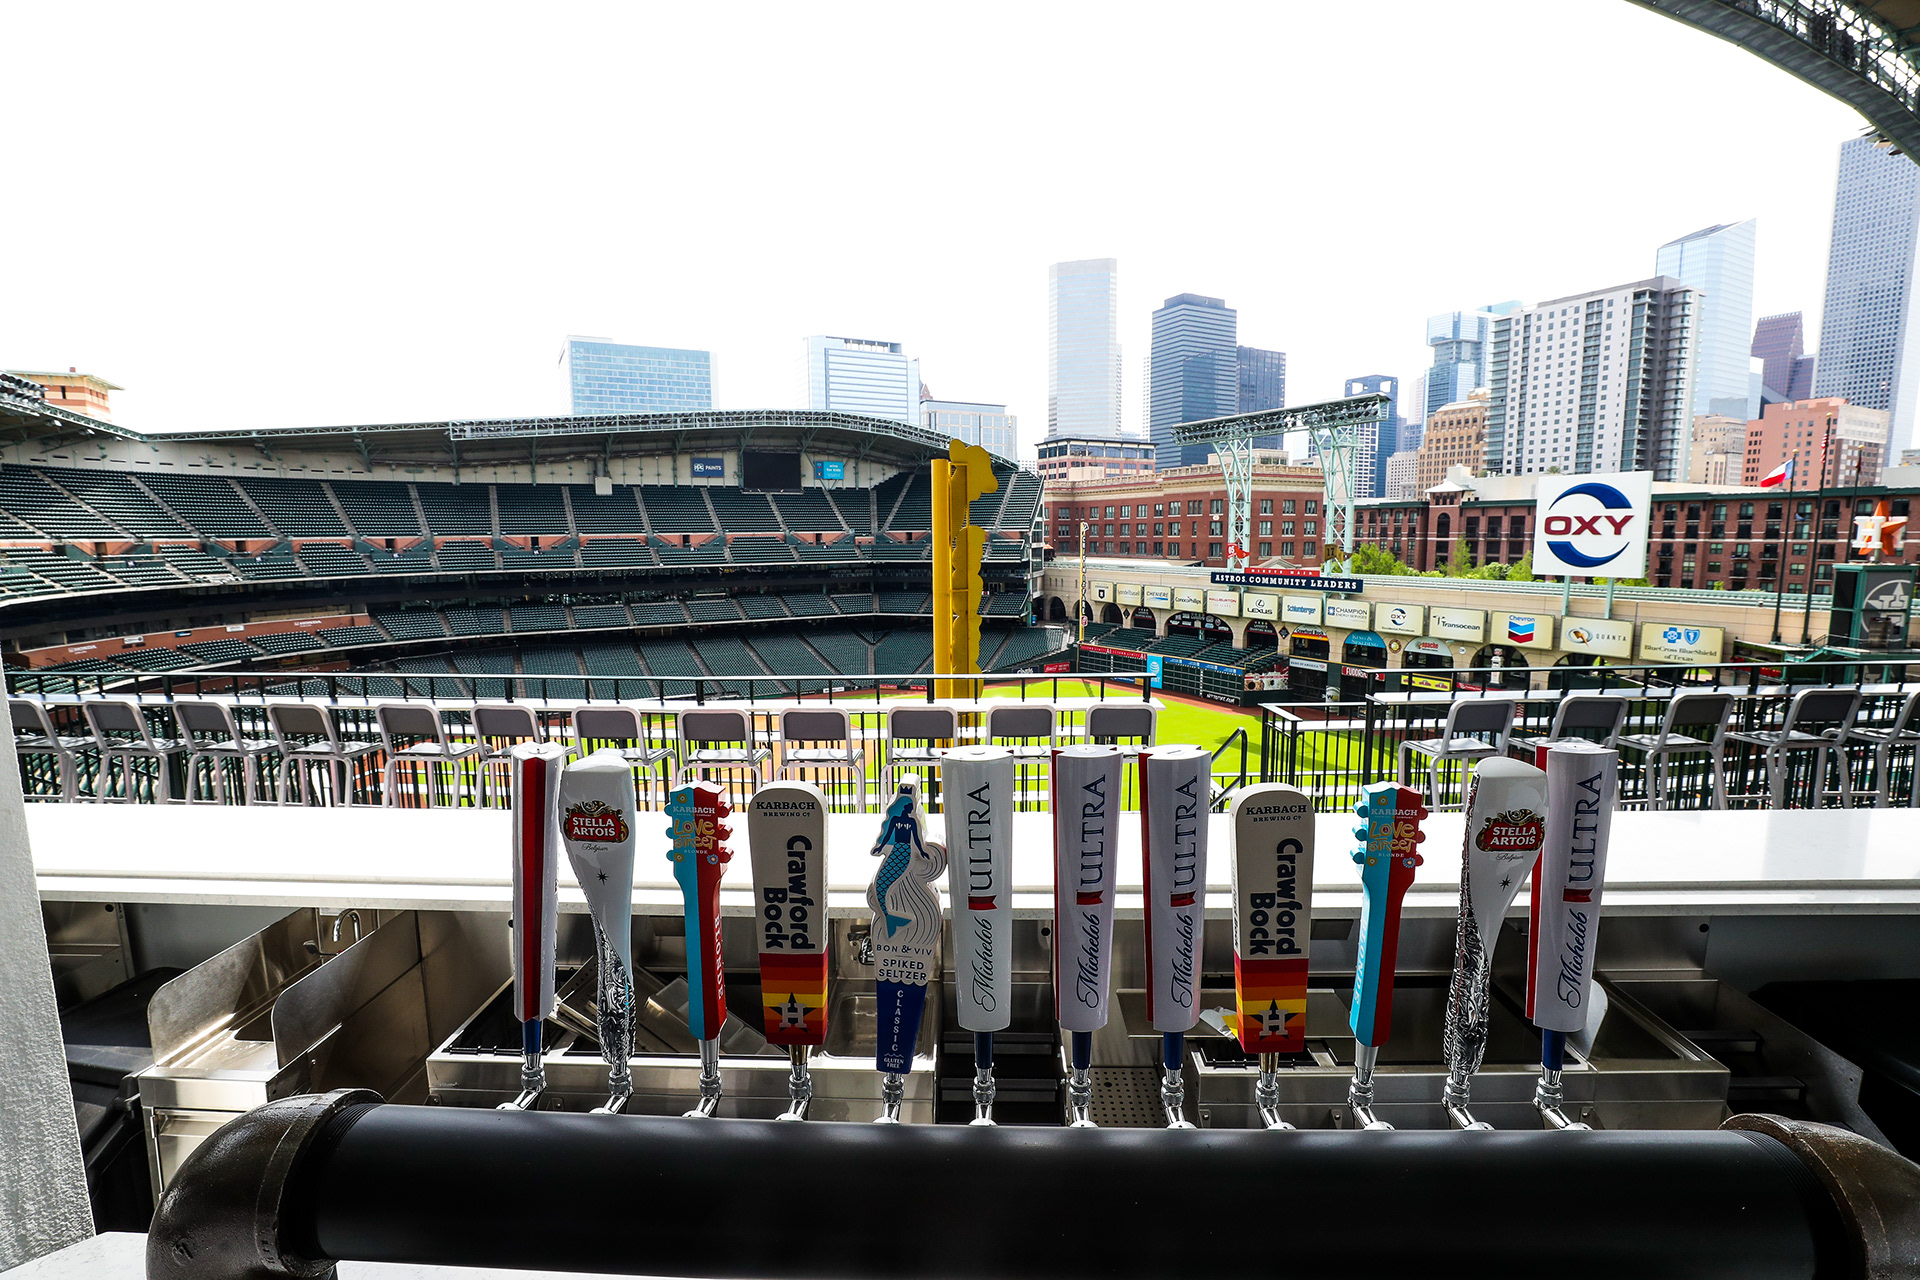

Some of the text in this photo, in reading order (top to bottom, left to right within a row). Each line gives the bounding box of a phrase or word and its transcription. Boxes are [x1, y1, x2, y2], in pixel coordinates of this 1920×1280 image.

[1544, 514, 1635, 536] OXY
[1852, 516, 1886, 548] H
[1327, 547, 1334, 556] 17
[1249, 576, 1306, 586] COMMUNITY
[1310, 580, 1357, 589] LEADERS
[1287, 604, 1317, 616] Schlumberger
[1336, 607, 1367, 615] CHAMPION
[1442, 620, 1480, 630] Transocean
[1644, 644, 1717, 656] BlueCross BlueShield
[756, 801, 815, 810] KARBACH
[1246, 805, 1307, 815] KARBACH
[573, 817, 614, 826] STELLA
[573, 827, 615, 837] ARTOIS
[1493, 827, 1536, 836] STELLA
[1490, 836, 1536, 845] ARTOIS
[582, 843, 608, 853] Belgium
[1496, 853, 1524, 862] Belgium
[787, 834, 815, 949] Crawford
[1076, 774, 1105, 1008] Michelob ULTRA
[1171, 775, 1197, 1008] Michelob ULTRA
[1557, 771, 1602, 1008] Michelob ULTRA
[967, 782, 996, 1012] Michelob ULTRA
[1276, 838, 1303, 955] Crawford
[763, 887, 789, 949] Bock
[1250, 893, 1275, 955] Bock
[901, 945, 911, 953] &
[914, 947, 932, 955] VIV
[883, 958, 924, 969] SPIKED
[879, 969, 926, 980] SELTZER
[778, 1002, 807, 1028] H
[892, 990, 904, 1052] CLASSIC
[1257, 1009, 1289, 1036] H
